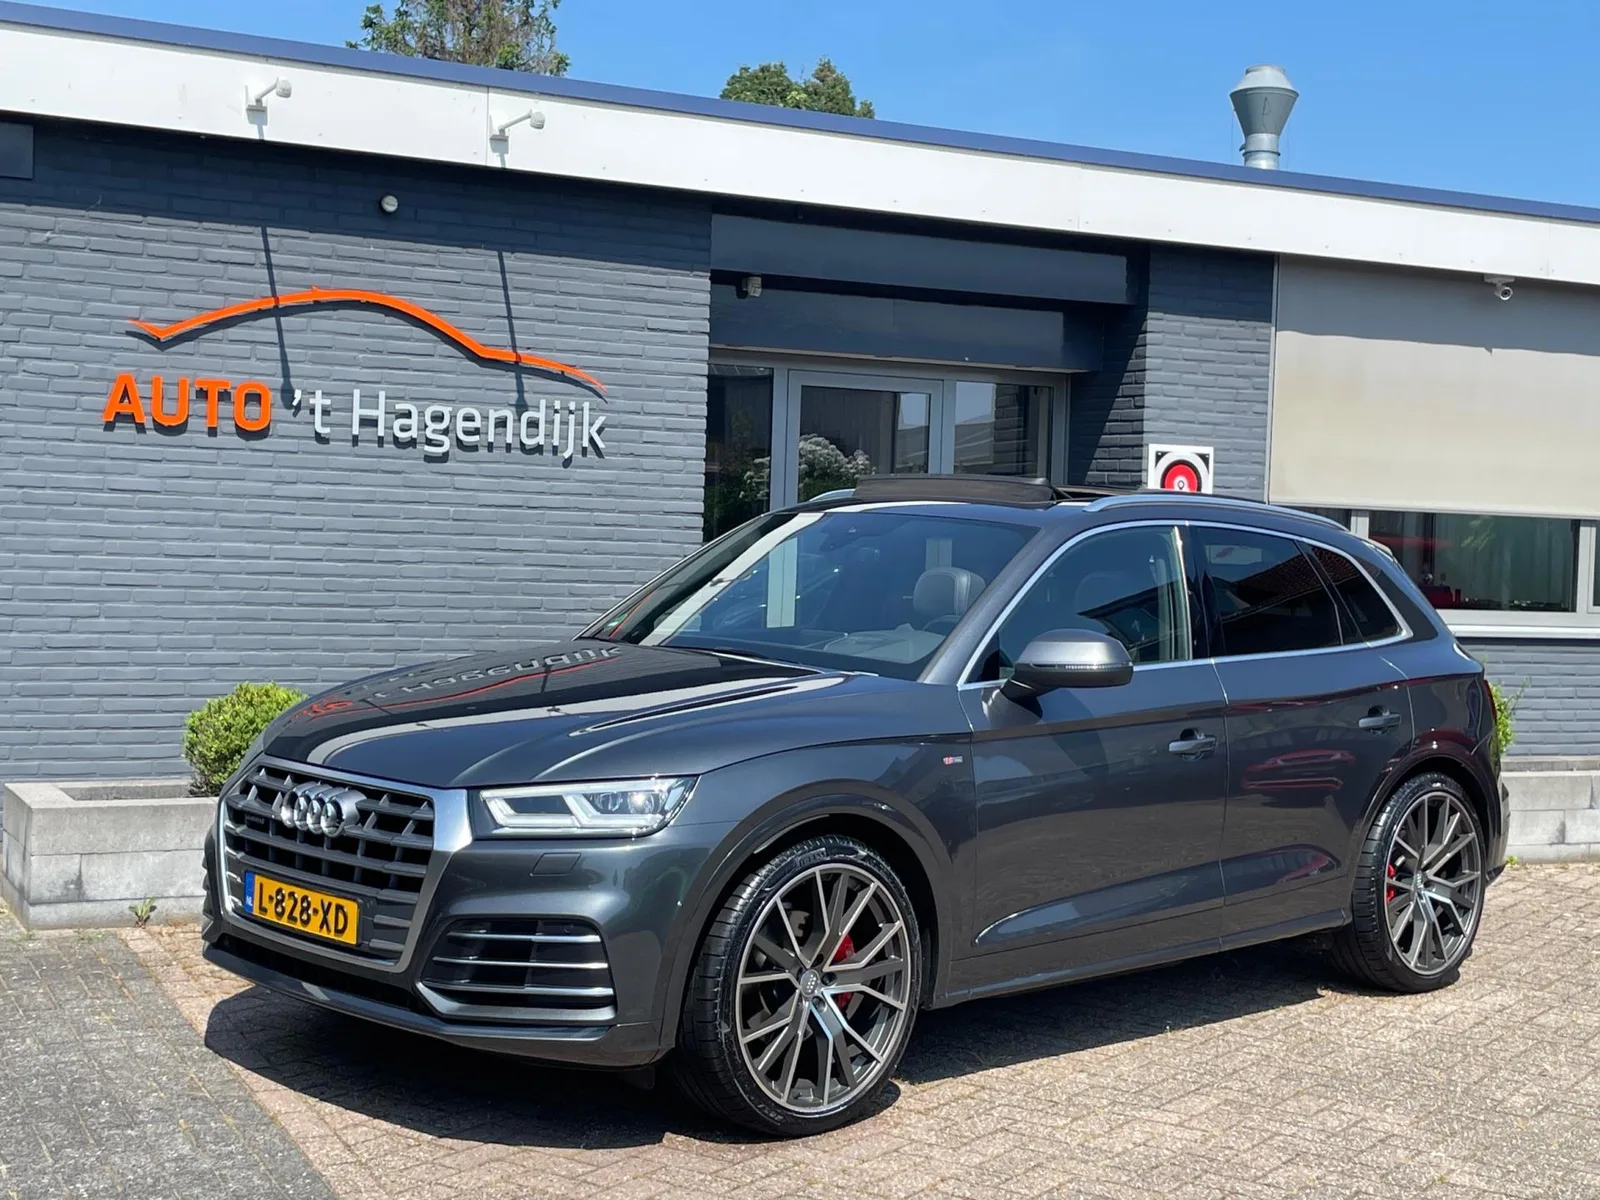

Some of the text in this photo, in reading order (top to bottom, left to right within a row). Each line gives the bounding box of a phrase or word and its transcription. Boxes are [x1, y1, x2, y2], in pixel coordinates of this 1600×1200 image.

[102, 373, 272, 432] AUTO
[352, 388, 607, 460] Hagendijk
[257, 882, 349, 936] L-828-XD
